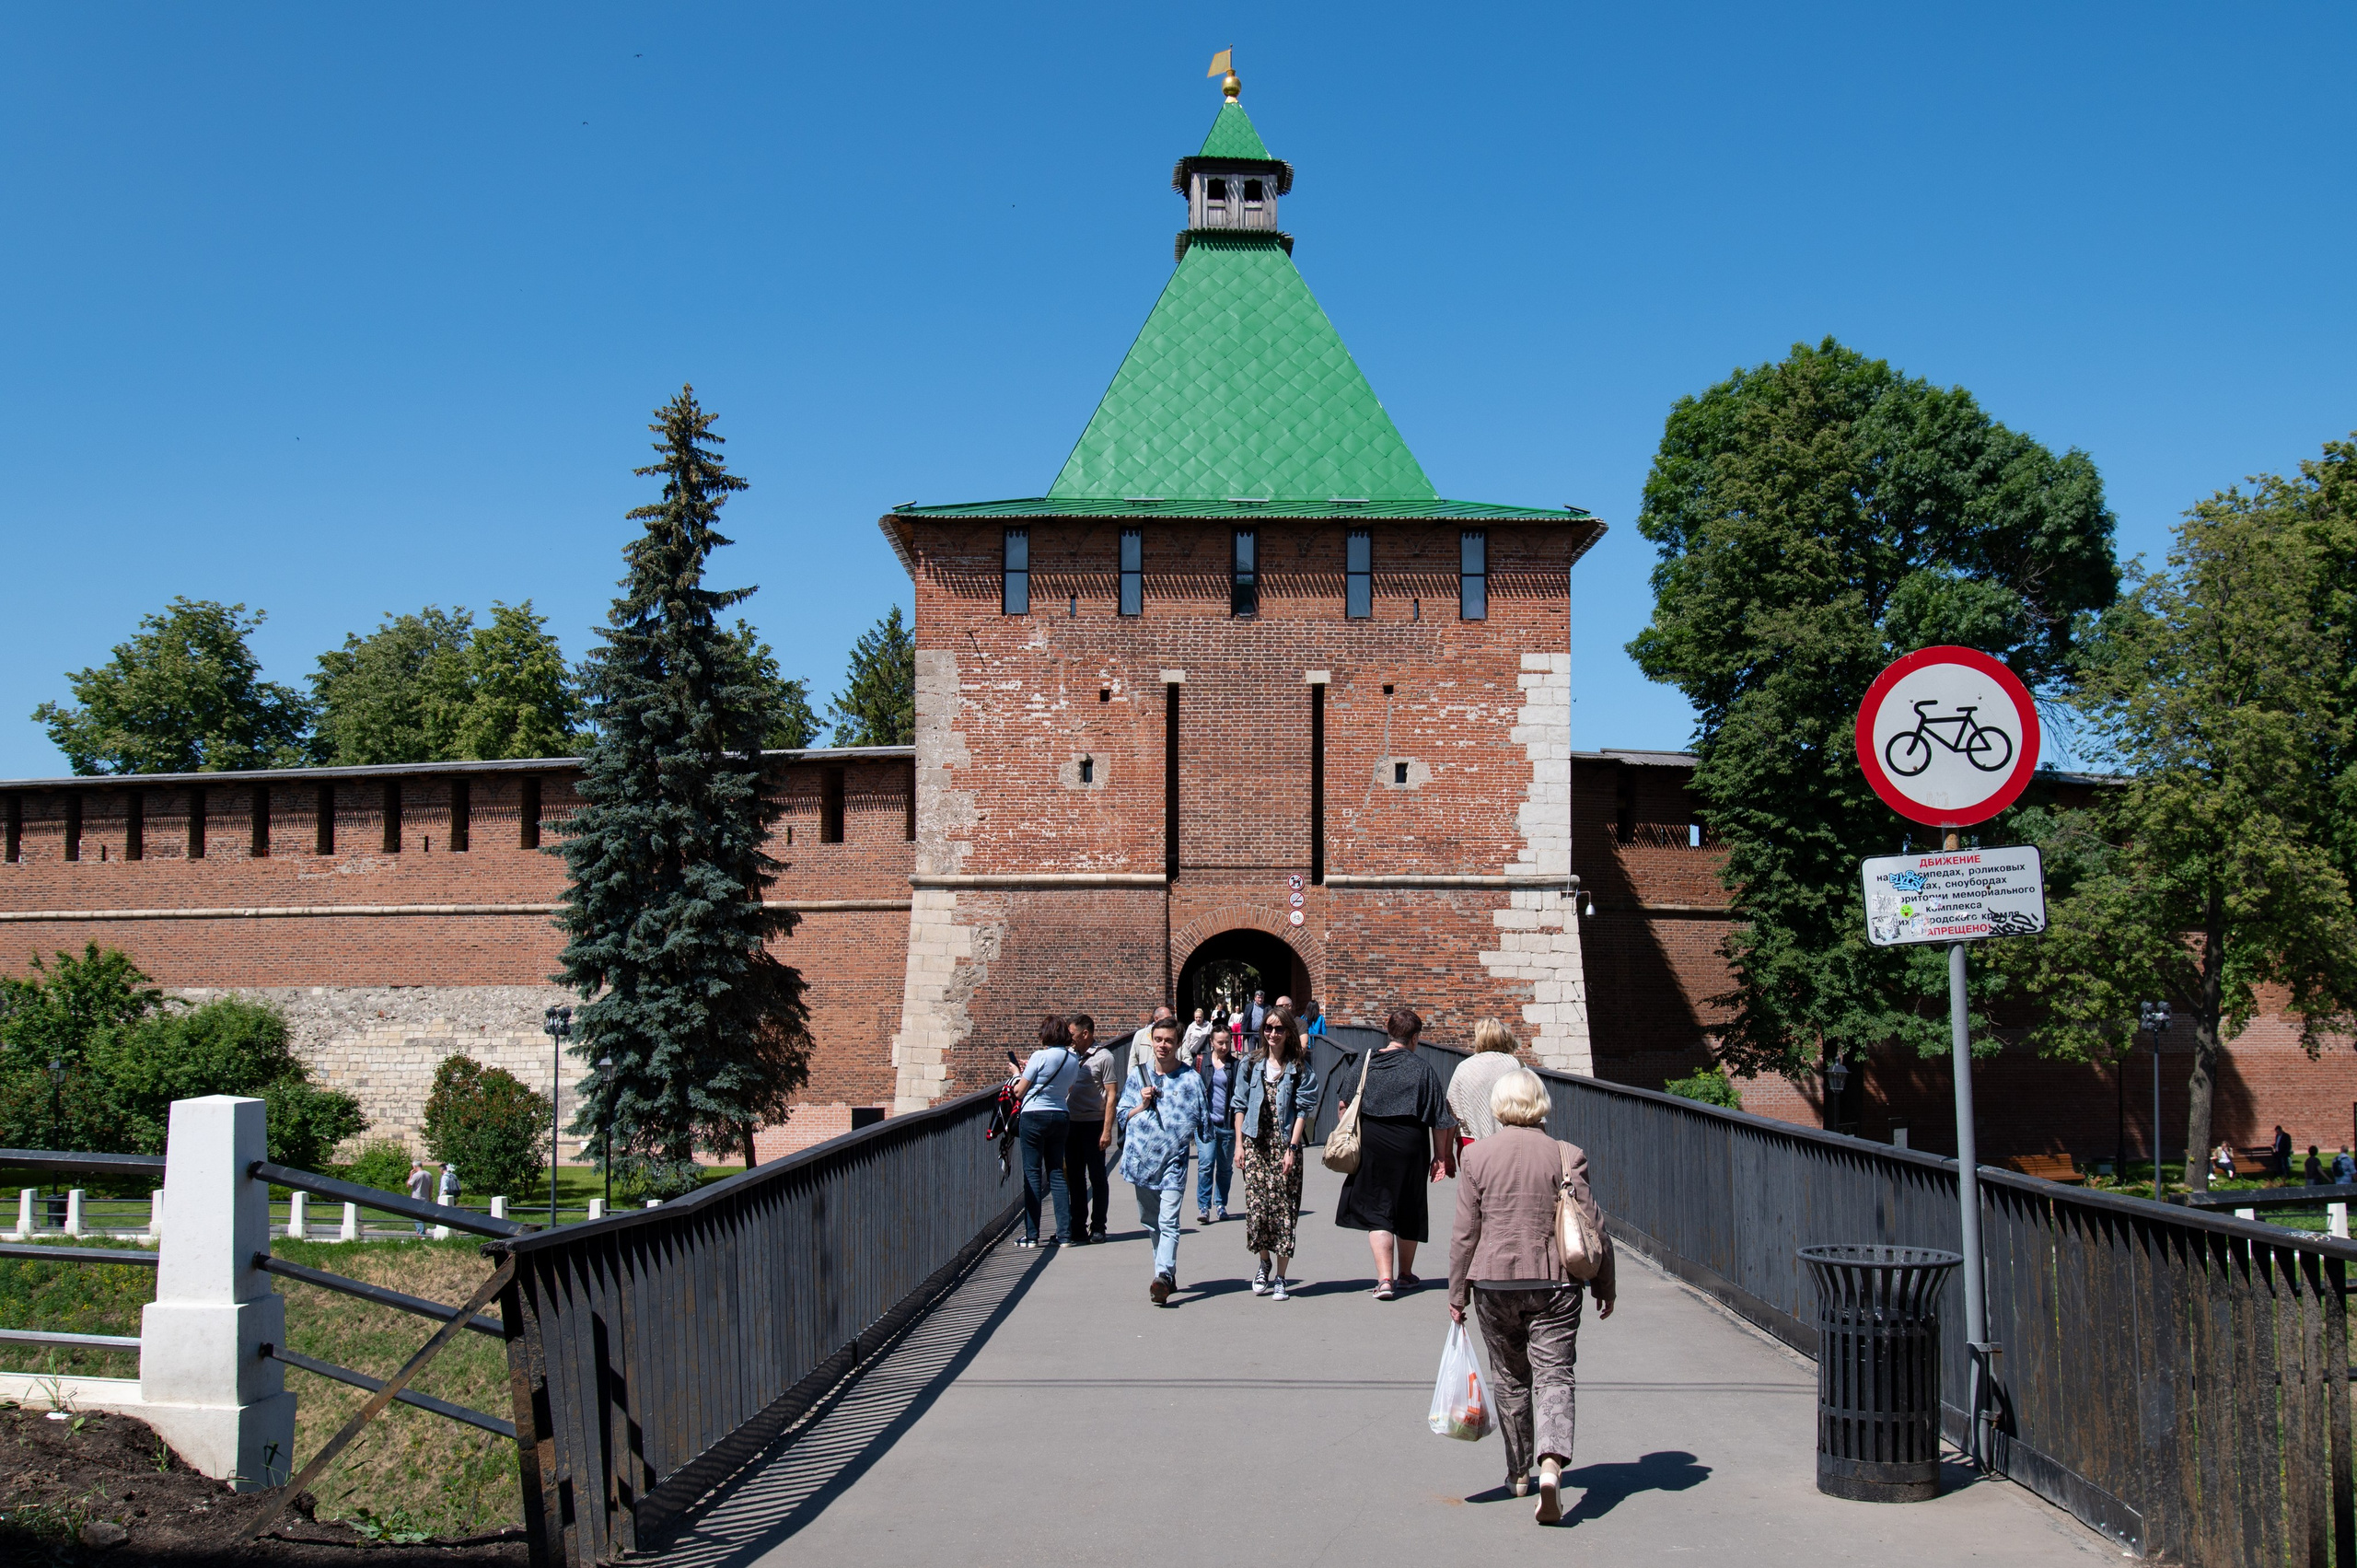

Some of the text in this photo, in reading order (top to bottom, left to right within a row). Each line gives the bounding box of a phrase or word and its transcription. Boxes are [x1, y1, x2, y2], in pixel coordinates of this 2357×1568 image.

[1919, 854, 1981, 868] ДВИЖЕНИЕ
[1914, 868, 1965, 878] сипедах,
[1968, 864, 2026, 876] роликовых
[1945, 877, 2007, 889] сноубордах
[1952, 887, 2036, 899] мемориального
[1927, 923, 1991, 936] АПРЕЩЕНО!
